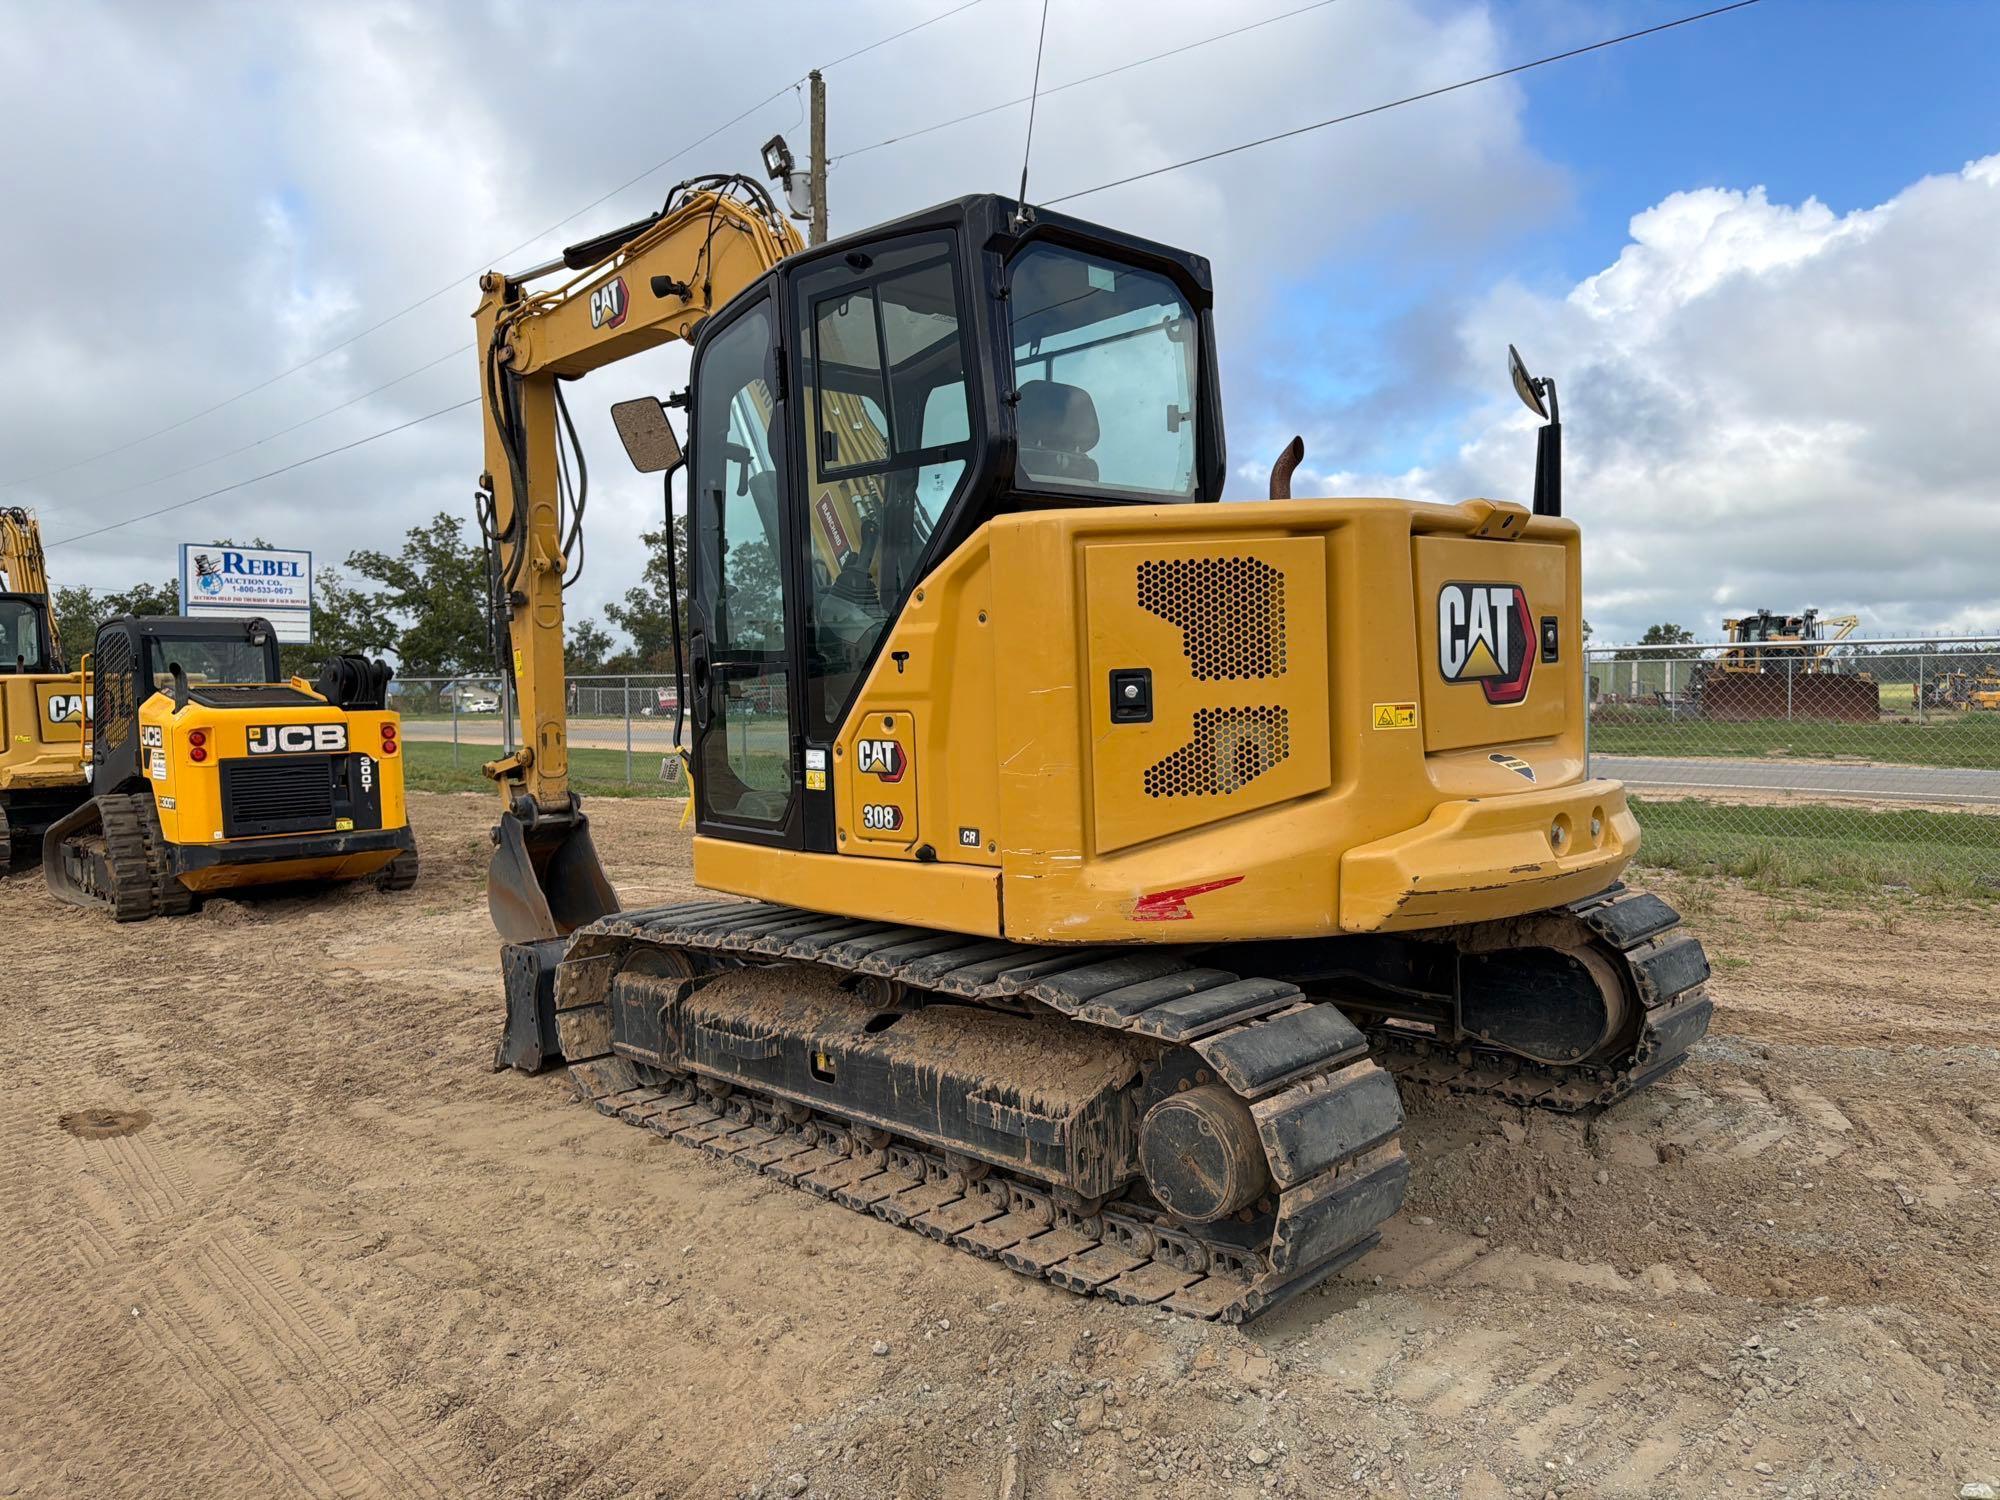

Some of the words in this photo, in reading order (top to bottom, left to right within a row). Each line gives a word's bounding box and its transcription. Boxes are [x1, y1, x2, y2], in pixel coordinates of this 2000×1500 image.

[590, 279, 619, 328] CAT
[222, 552, 305, 578] REBEL
[224, 577, 265, 586] AUCTION
[267, 579, 283, 587] CO.
[232, 585, 293, 595] 1-800-533-0673
[1438, 585, 1514, 679] CAT
[142, 726, 162, 746] JCB
[249, 724, 347, 753] JCB
[858, 740, 895, 773] CAT
[360, 756, 372, 792] 300T
[863, 805, 894, 829] 308
[962, 831, 976, 844] CR
